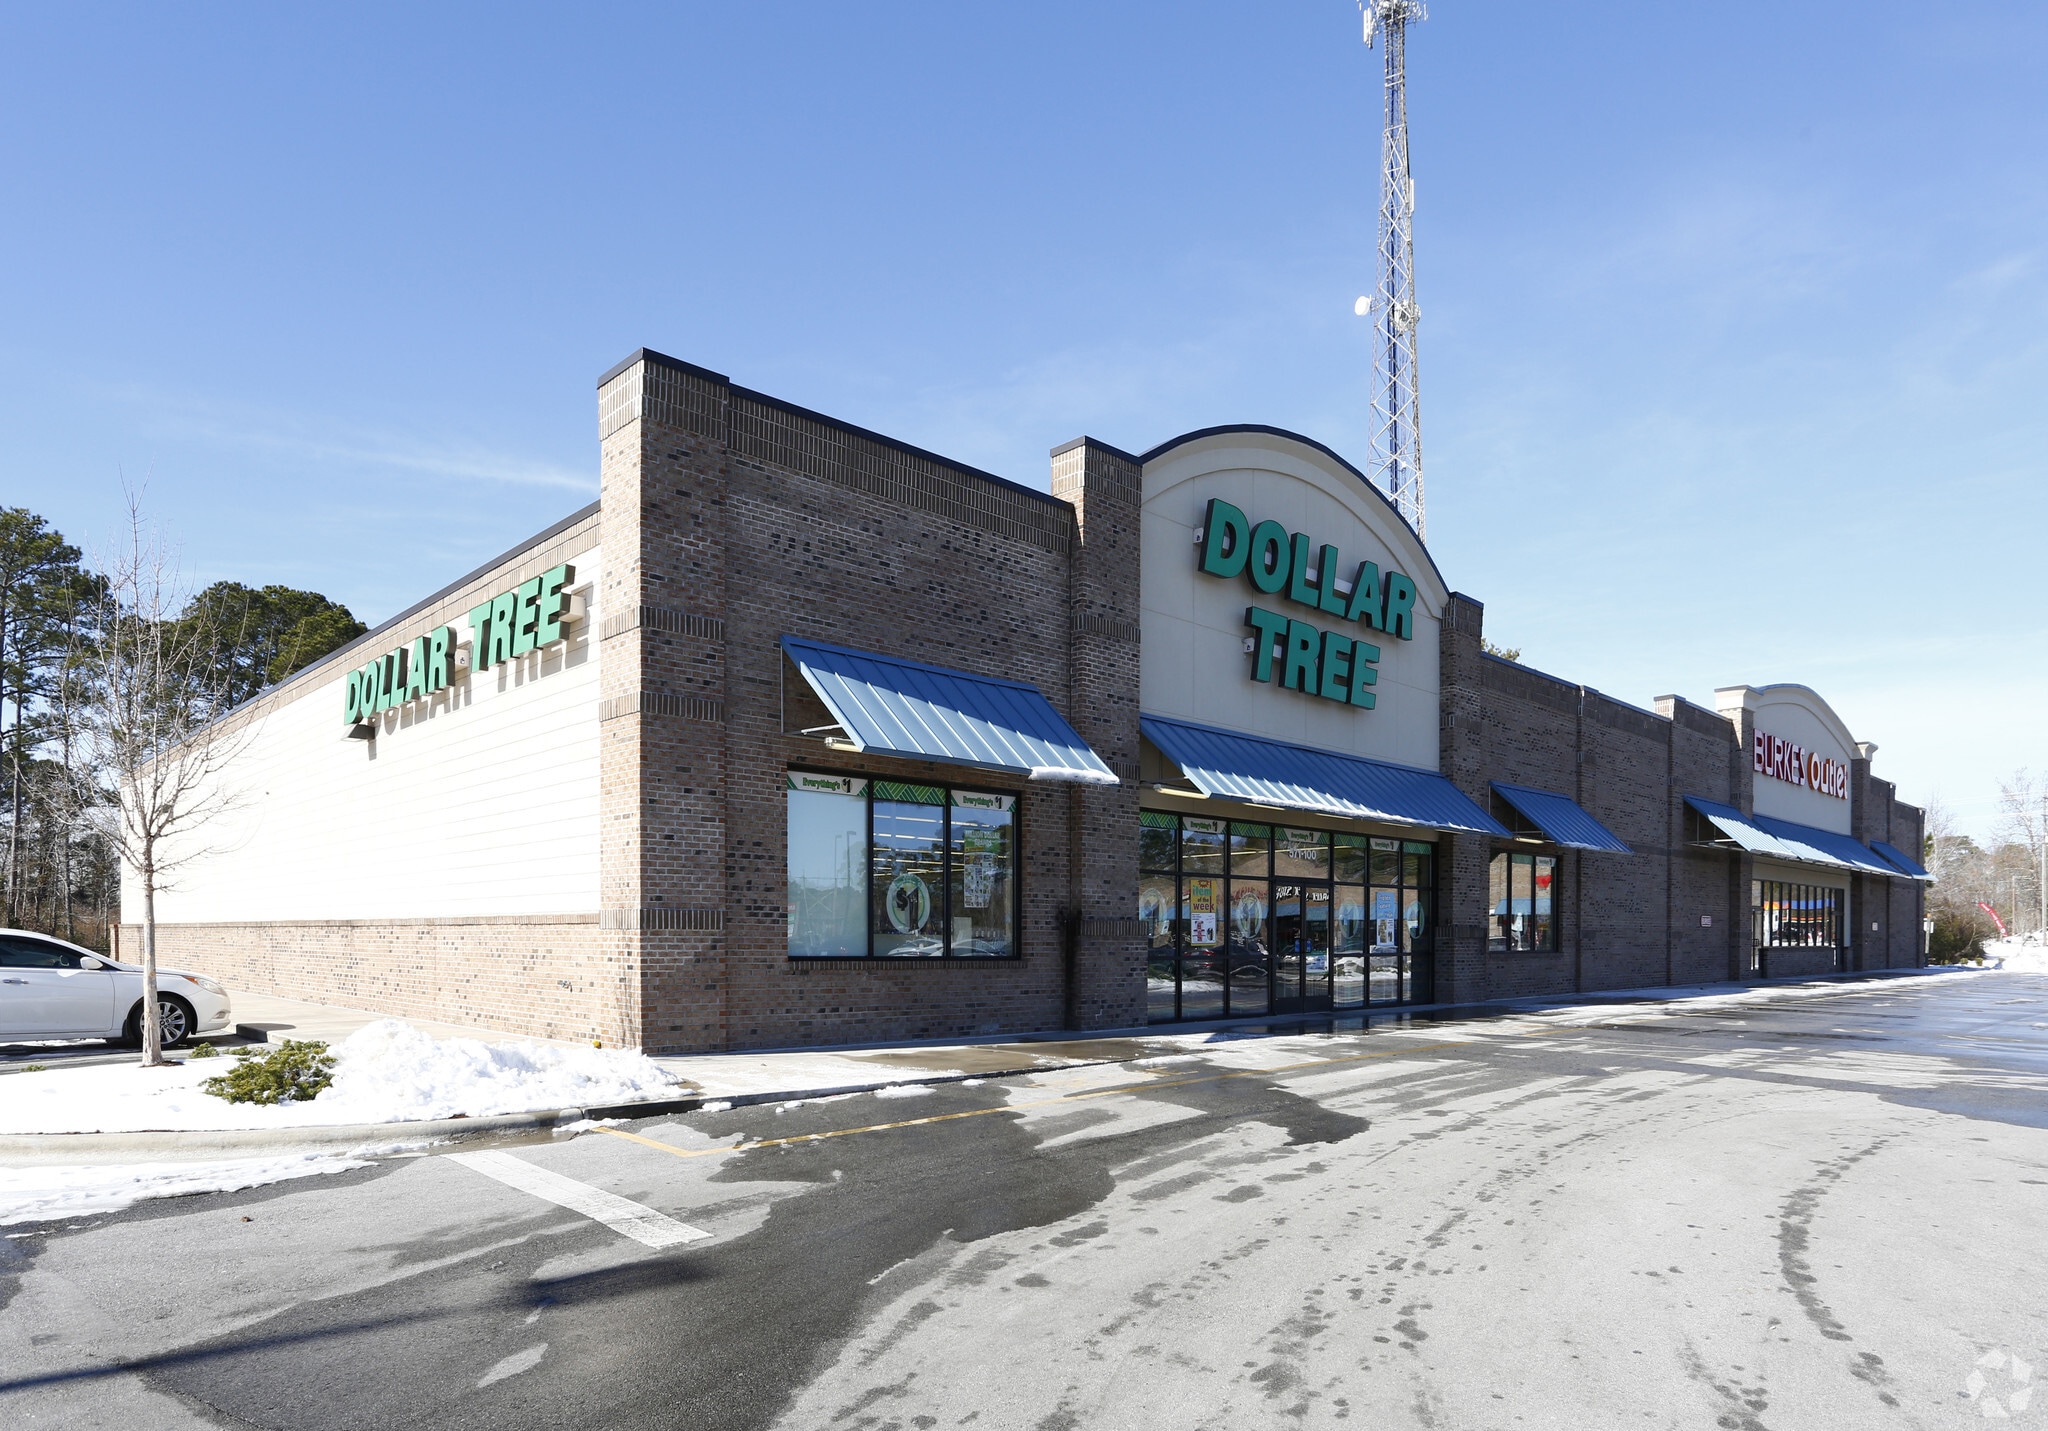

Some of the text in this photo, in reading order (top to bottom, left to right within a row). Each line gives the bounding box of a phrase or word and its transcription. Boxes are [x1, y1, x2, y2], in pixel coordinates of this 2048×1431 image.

[1198, 498, 1416, 640] DOLLAR
[344, 564, 576, 725] DOLLAR TREE
[1244, 606, 1381, 710] TREE
[1753, 728, 1848, 800] BURKES Outlet
[1192, 885, 1212, 896] item
[1193, 902, 1215, 911] week
